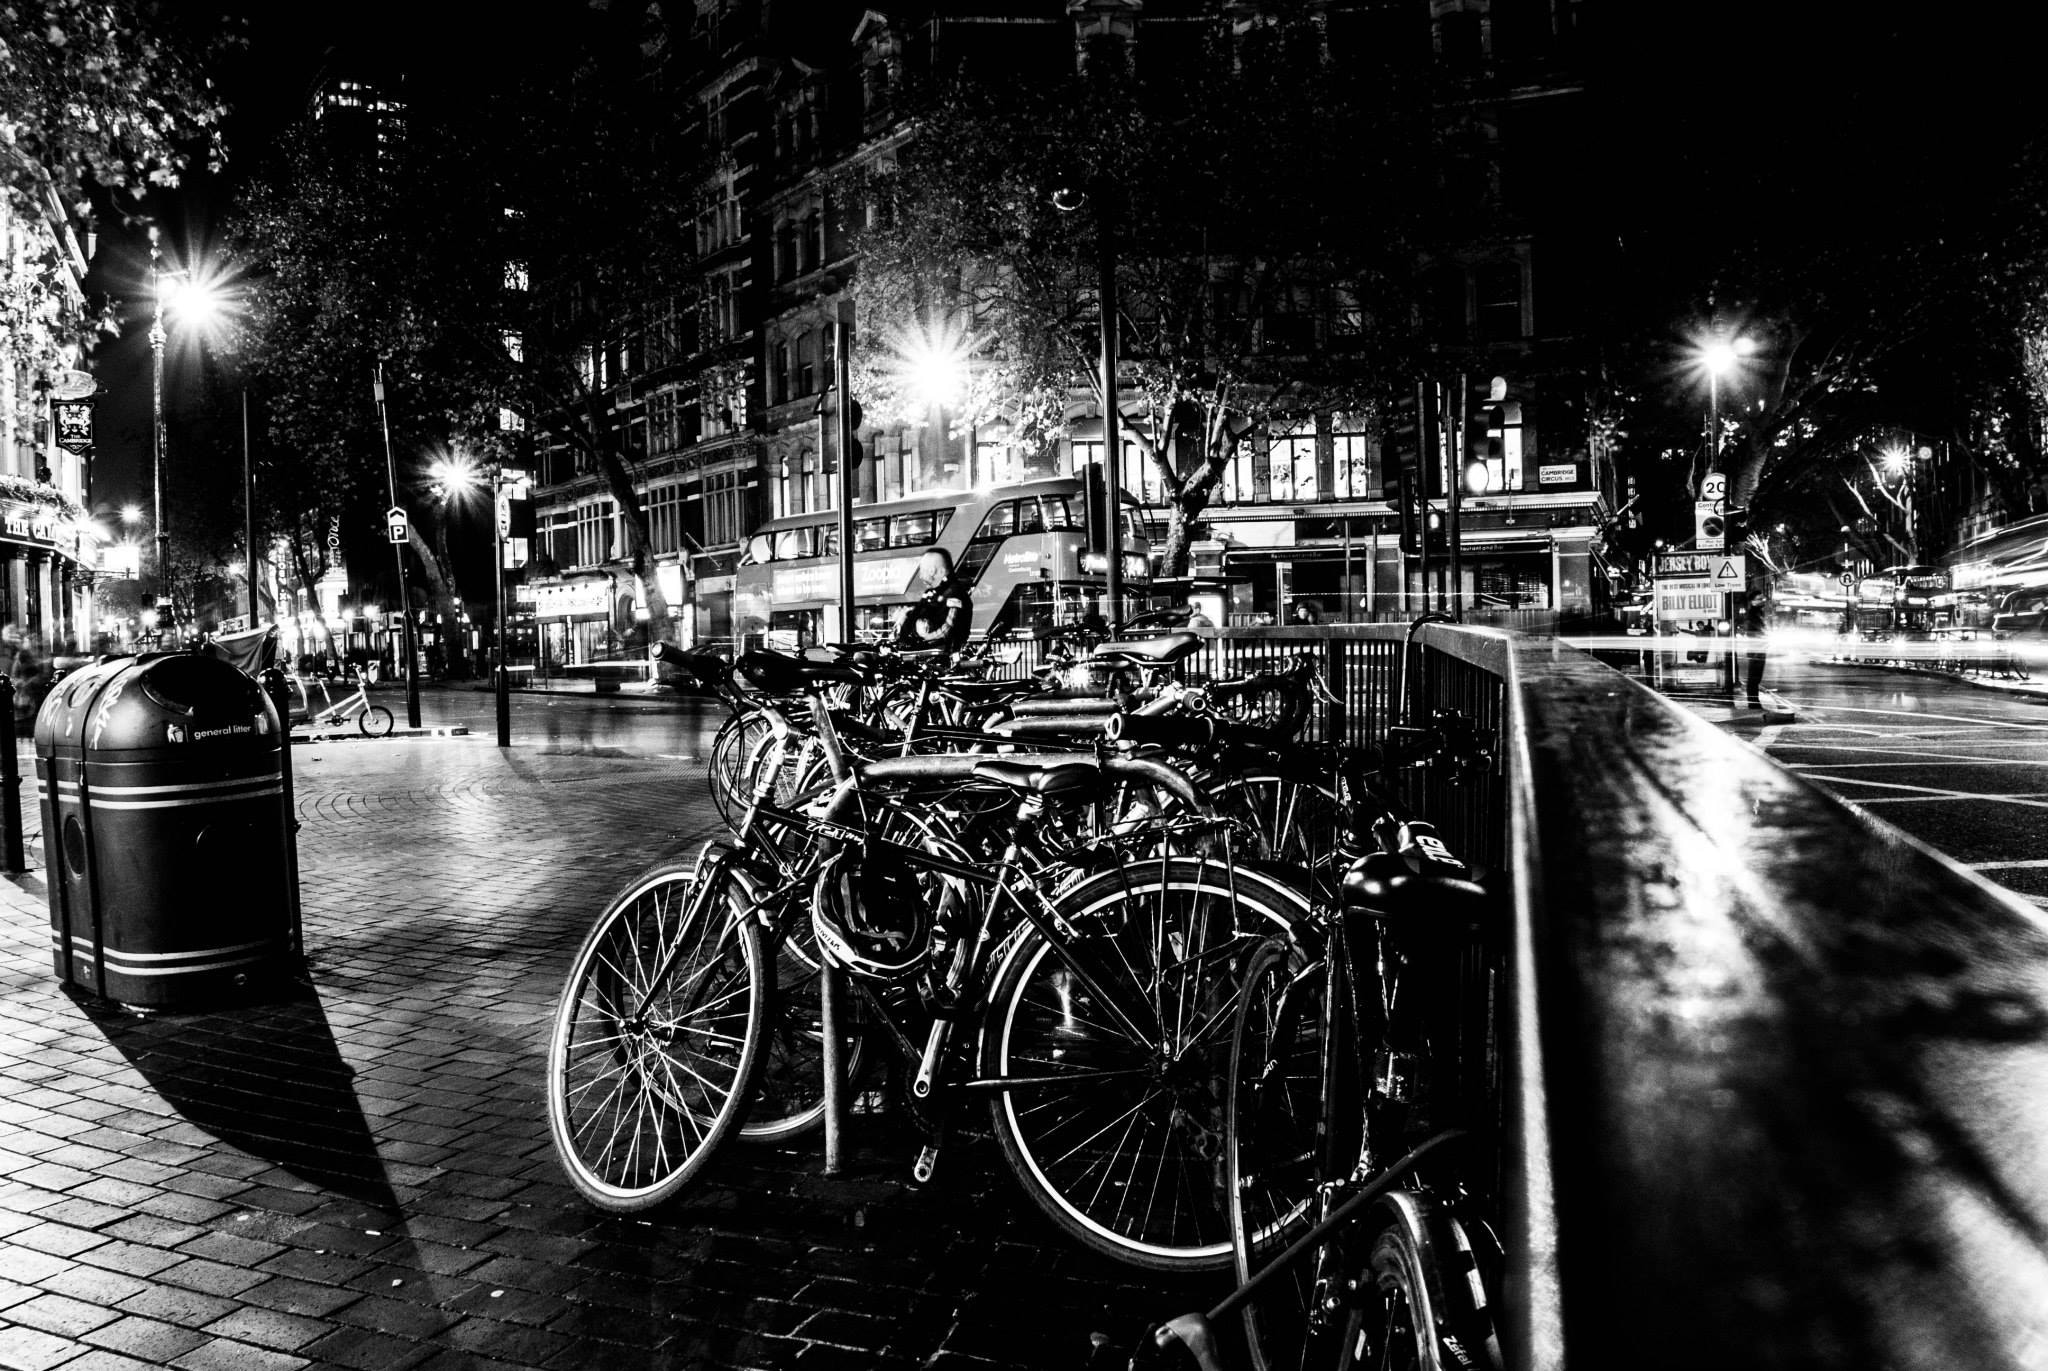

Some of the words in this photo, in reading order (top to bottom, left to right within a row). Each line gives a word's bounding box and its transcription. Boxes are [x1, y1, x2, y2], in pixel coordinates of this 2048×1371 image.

[5, 516, 29, 537] THE
[327, 515, 340, 549] Once
[393, 526, 404, 540] P
[1658, 556, 1692, 572] JERSEY
[1662, 595, 1685, 610] BILLY
[1689, 594, 1717, 609] ELLIOT
[194, 726, 231, 740] general
[233, 725, 251, 733] litter
